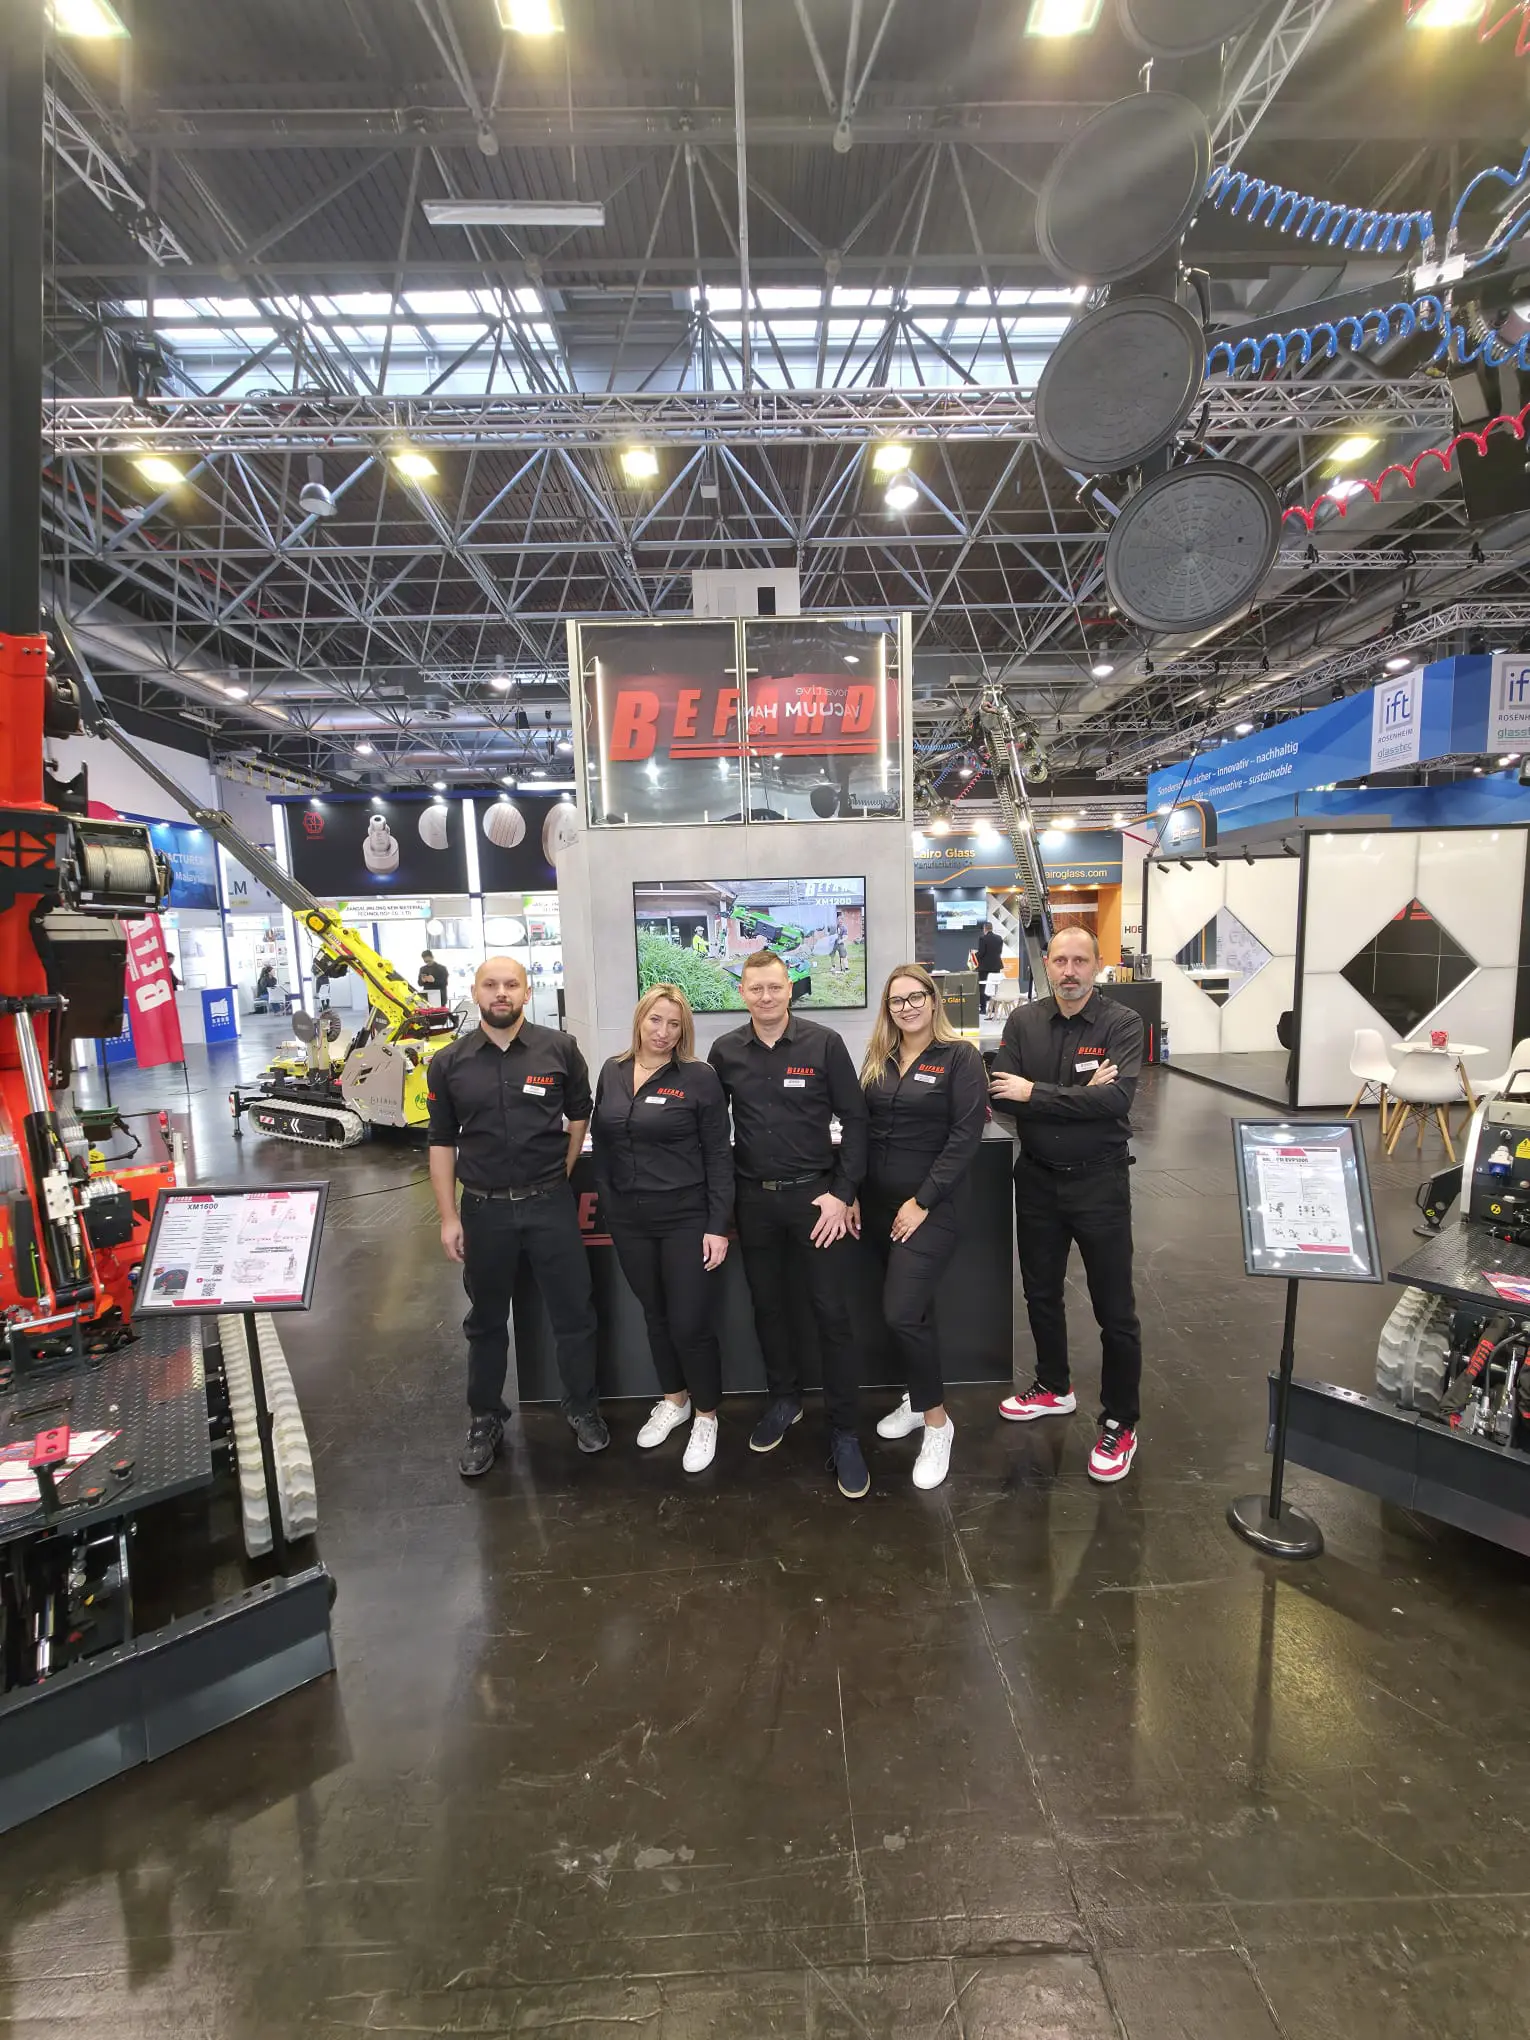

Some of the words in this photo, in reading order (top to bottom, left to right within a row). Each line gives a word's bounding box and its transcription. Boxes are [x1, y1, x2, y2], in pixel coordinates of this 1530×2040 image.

[1385, 690, 1411, 724] ift
[609, 685, 876, 761] BEFARD
[1377, 728, 1413, 744] ROSENHEIM
[1193, 771, 1212, 785] sicher
[1217, 759, 1250, 776] innovativ
[1256, 741, 1299, 764] nachhaltig
[1377, 742, 1413, 759] glasstec
[1208, 780, 1243, 797] innovative
[1248, 763, 1293, 785] sustainable
[945, 848, 976, 858] Glass
[786, 1066, 815, 1076] BEFARD
